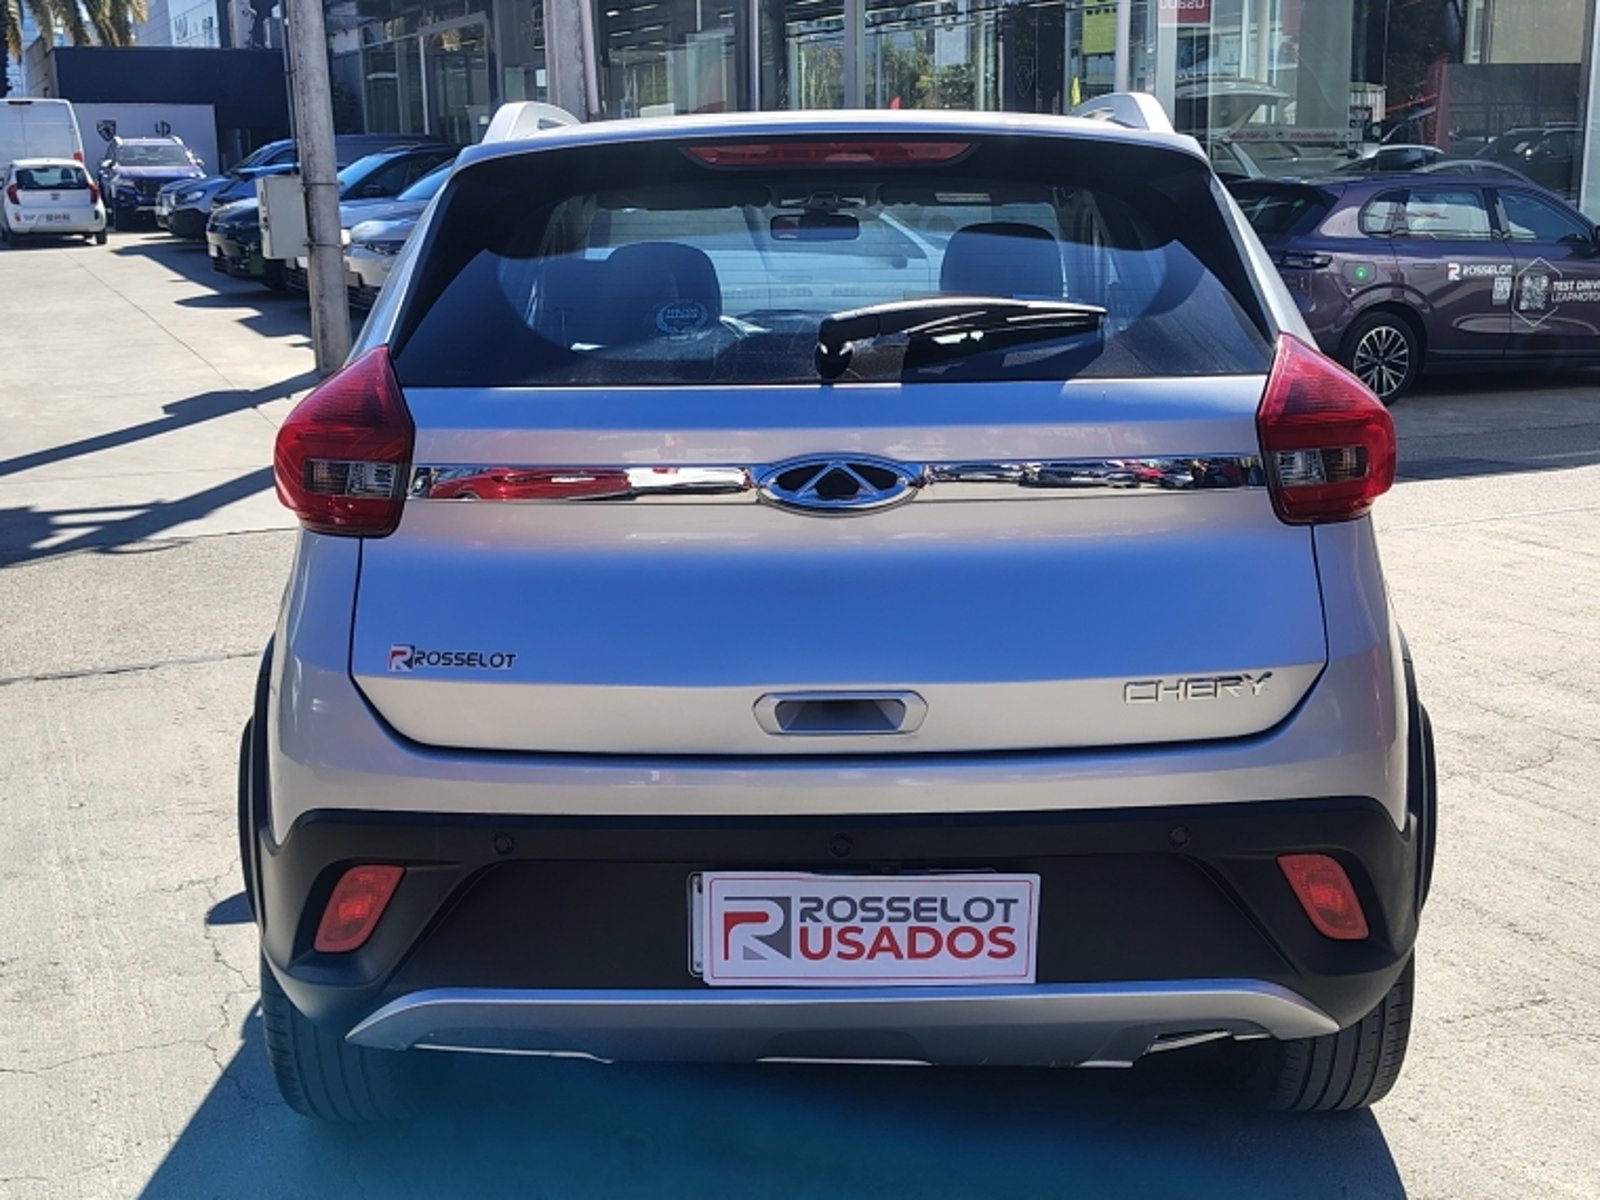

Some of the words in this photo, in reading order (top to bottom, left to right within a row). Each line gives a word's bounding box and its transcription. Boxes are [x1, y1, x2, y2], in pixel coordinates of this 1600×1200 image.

[1462, 264, 1512, 277] ROSSELOT
[1553, 281, 1575, 291] TEST
[414, 651, 516, 669] ROSSELOT
[1123, 671, 1273, 705] CHERY
[799, 895, 1019, 924] ROSSELOT
[799, 926, 1017, 961] USADOS
